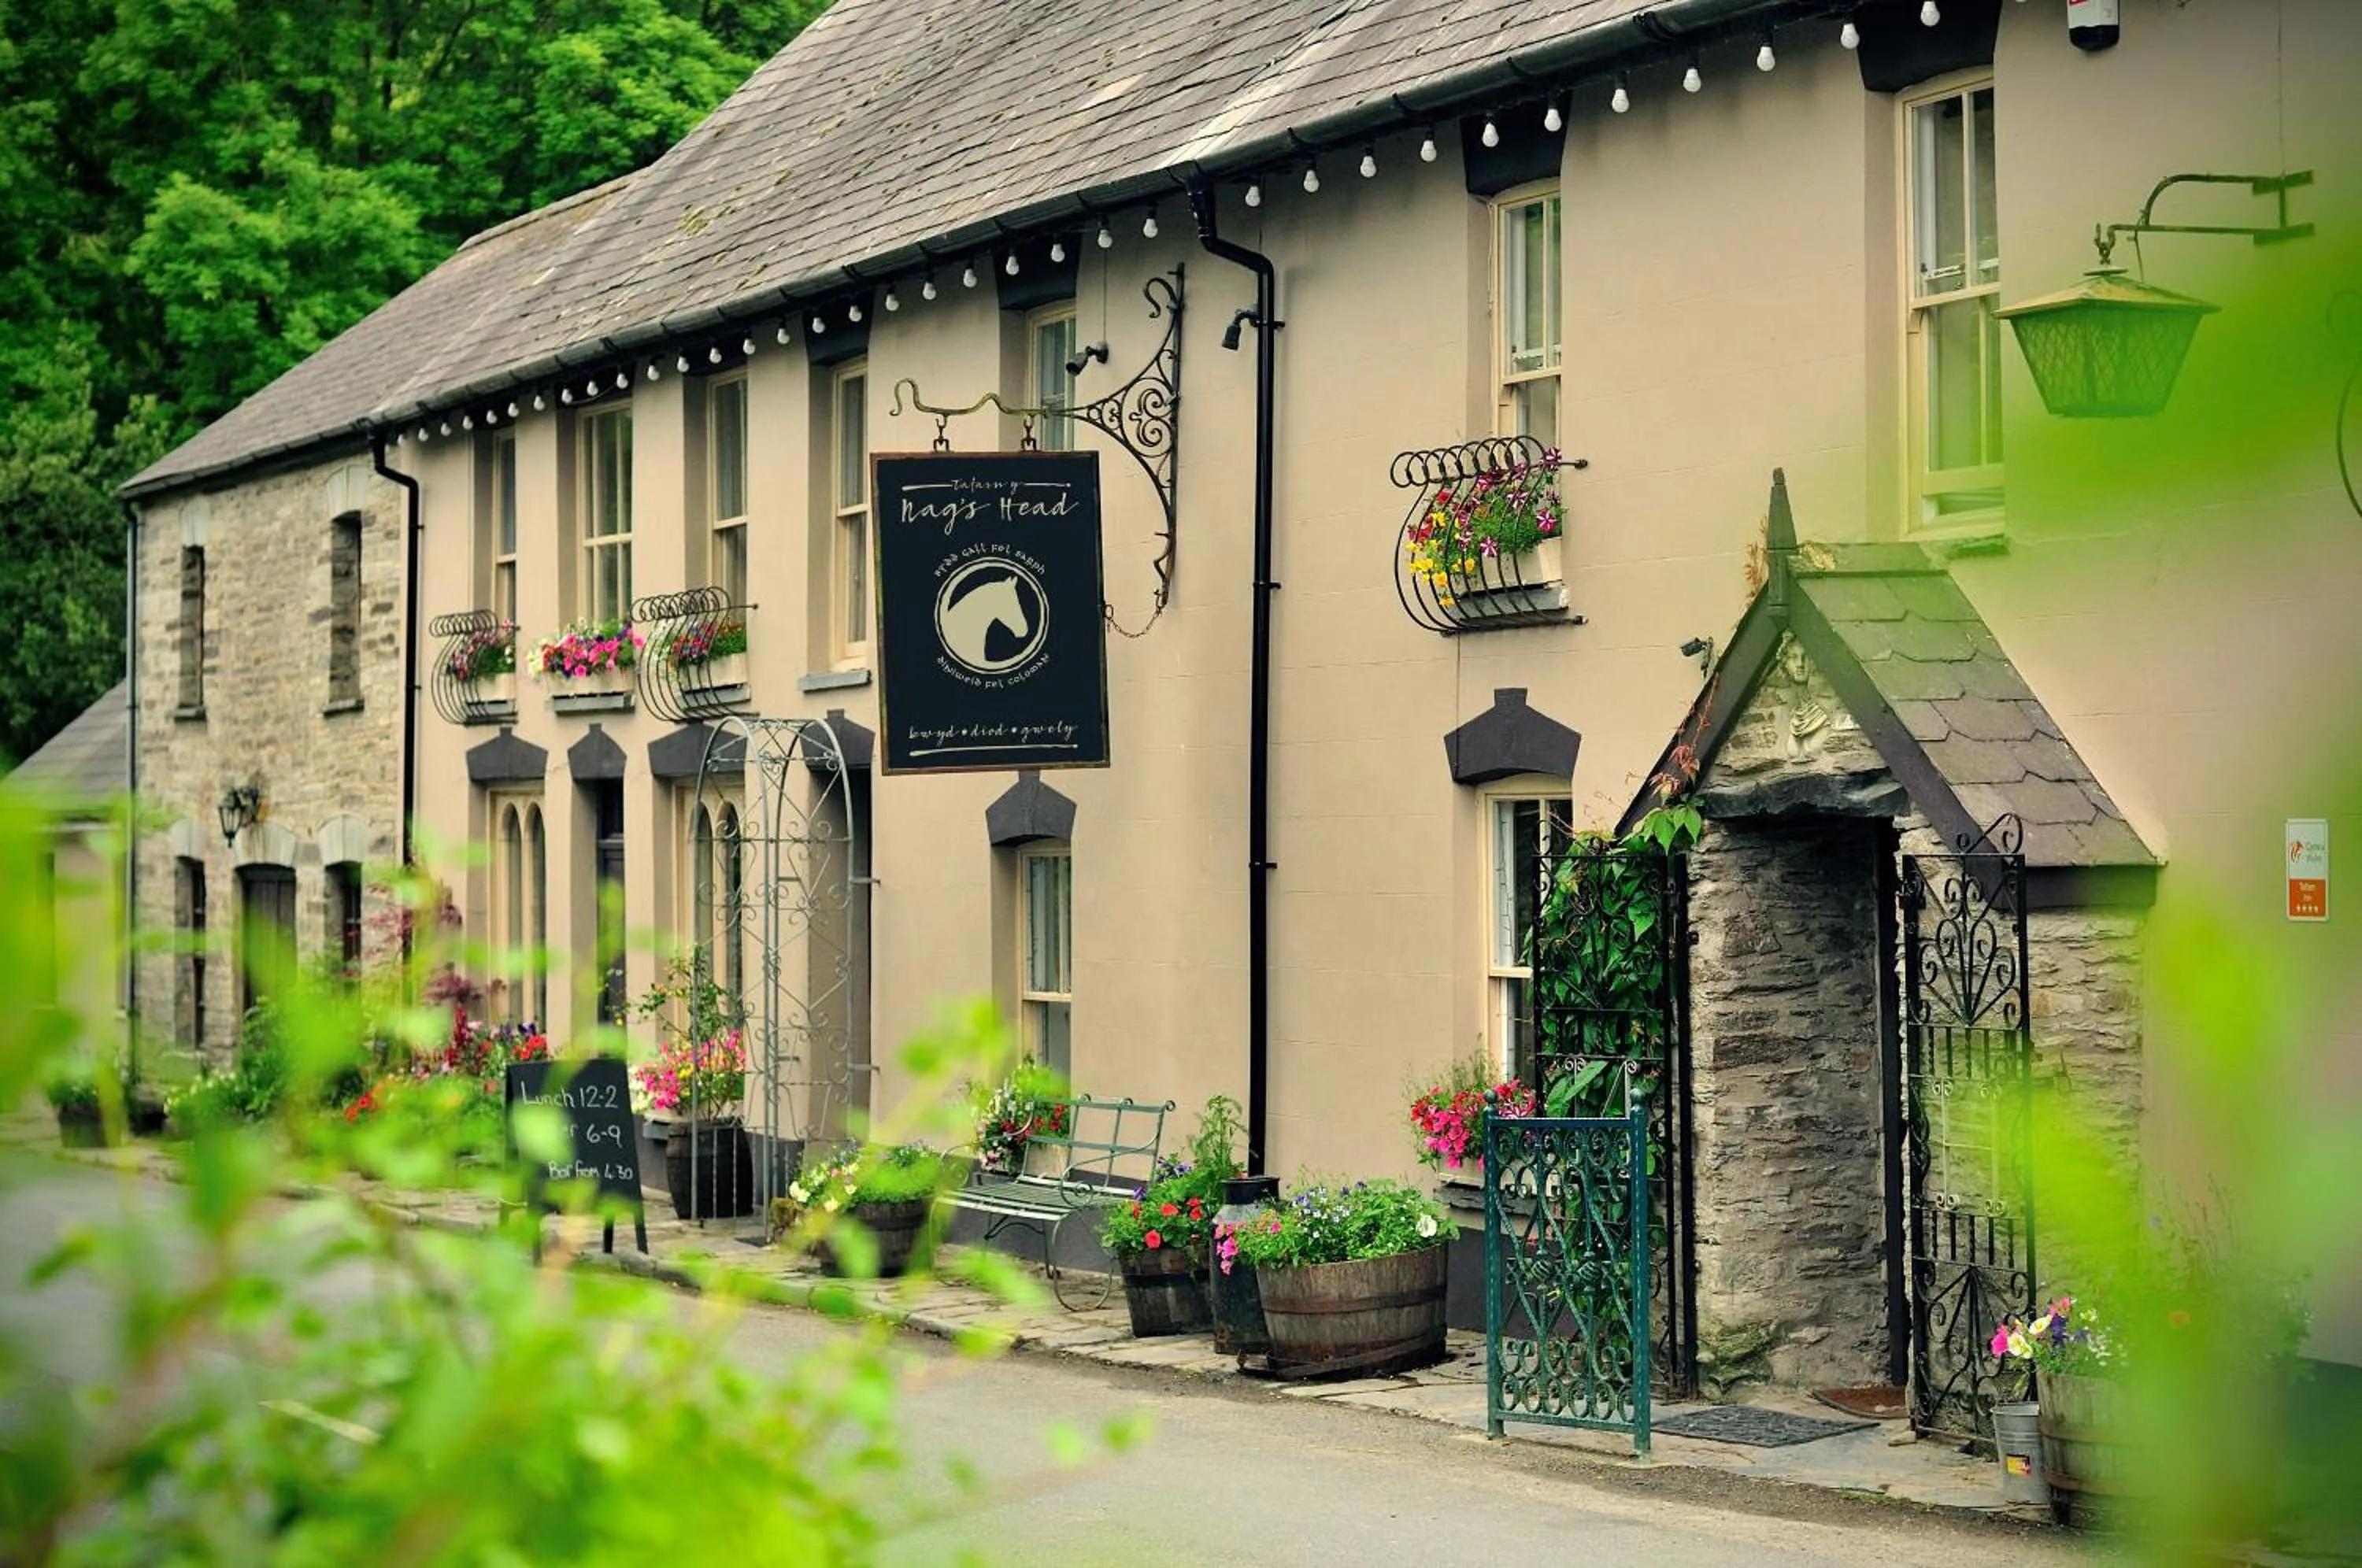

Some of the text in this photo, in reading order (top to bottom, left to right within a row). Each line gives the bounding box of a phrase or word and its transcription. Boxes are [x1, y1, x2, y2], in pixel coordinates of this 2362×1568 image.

[901, 492, 1079, 536] Nag's Head
[970, 723, 1008, 737] diod
[1020, 720, 1079, 742] gwely
[520, 1080, 576, 1109] Lunch
[587, 1124, 623, 1148] 6-9
